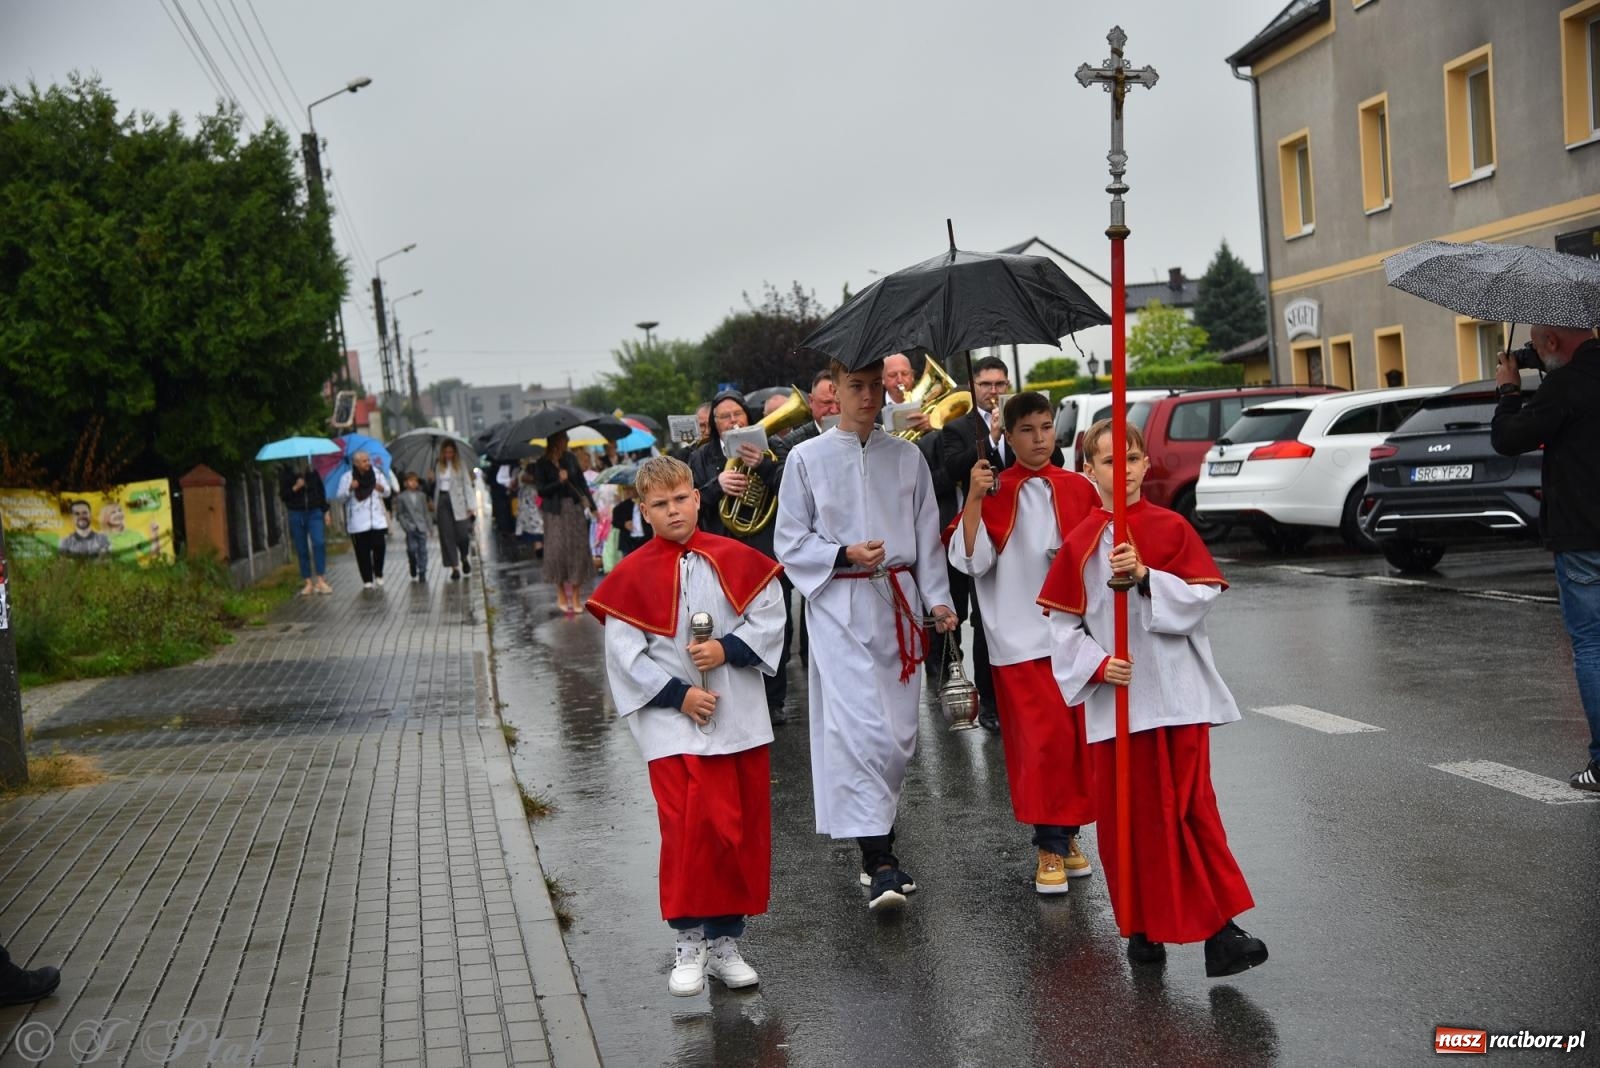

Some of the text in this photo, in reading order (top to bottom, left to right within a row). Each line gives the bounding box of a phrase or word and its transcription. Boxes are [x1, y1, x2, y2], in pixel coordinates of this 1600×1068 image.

[1287, 304, 1315, 328] SEGET
[1417, 465, 1470, 481] SRC YF22
